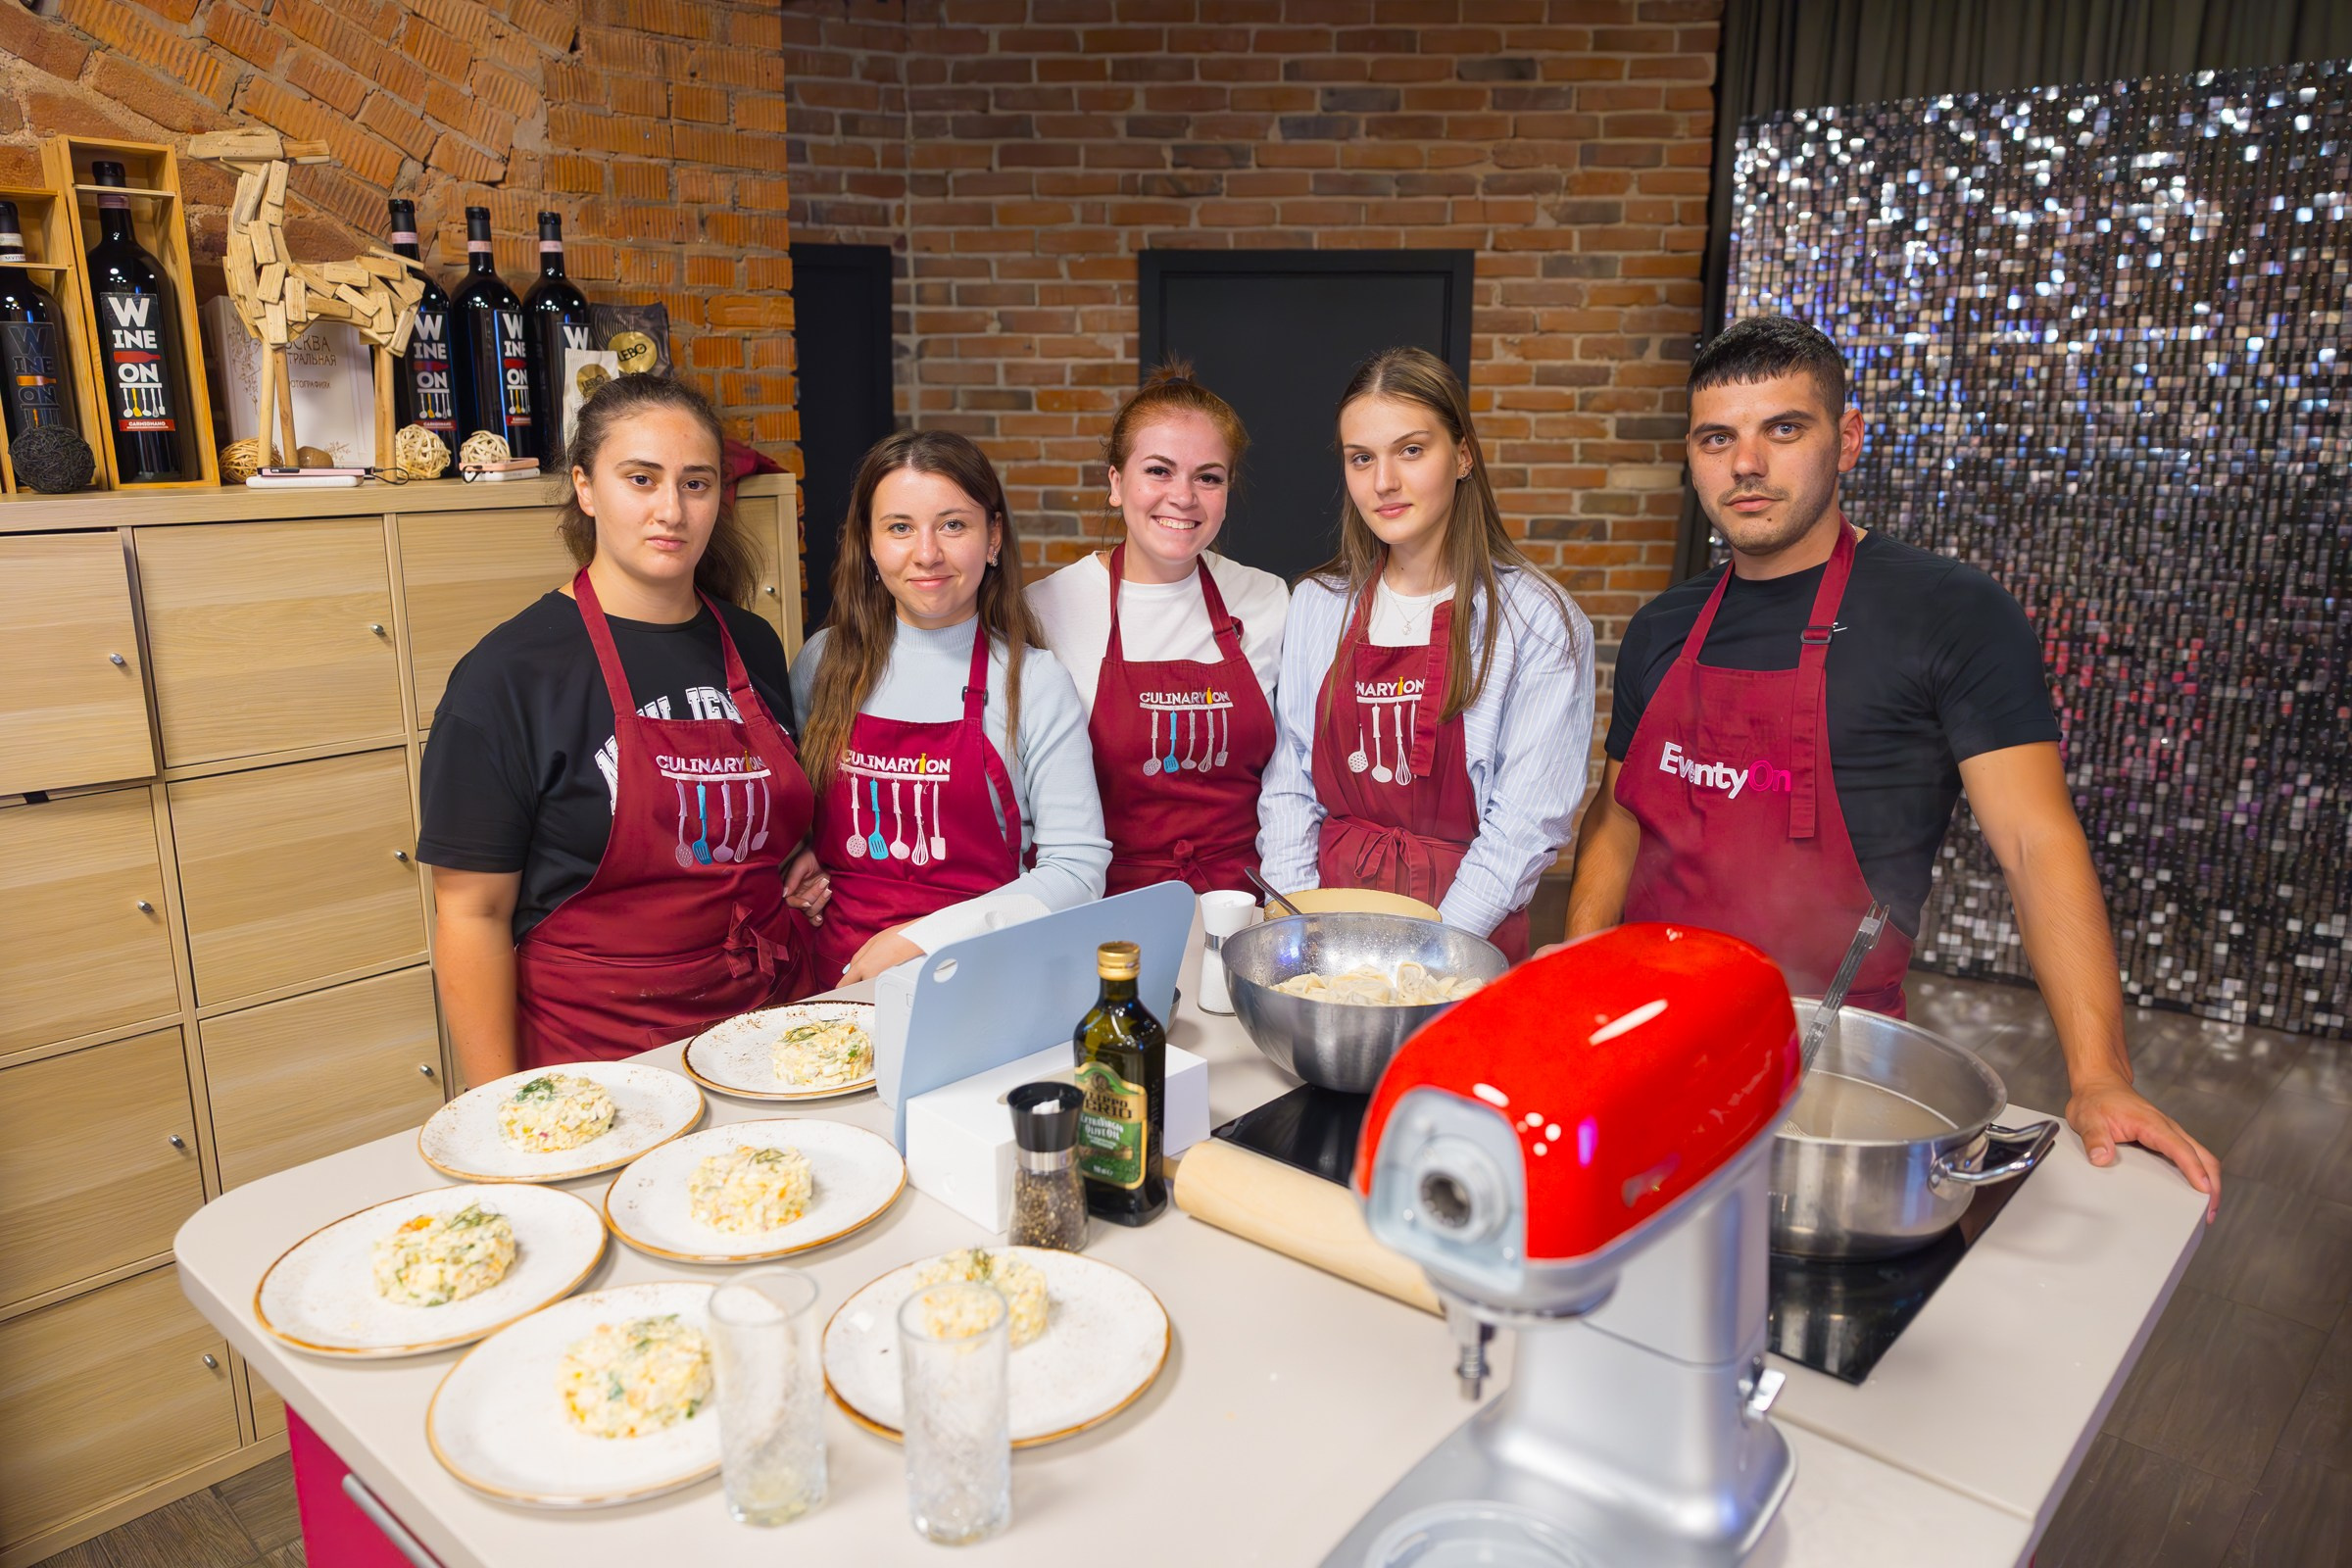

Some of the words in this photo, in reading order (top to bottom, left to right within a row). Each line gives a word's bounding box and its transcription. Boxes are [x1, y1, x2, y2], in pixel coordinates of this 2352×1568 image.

[107, 296, 150, 327] W
[414, 314, 443, 341] W
[502, 313, 523, 339] W
[112, 329, 158, 349] INE
[287, 352, 337, 367] ТРАЛЬНАЯ
[413, 342, 447, 360] INE
[617, 343, 647, 362] LEBO
[118, 363, 159, 383] ON
[416, 371, 448, 388] ON
